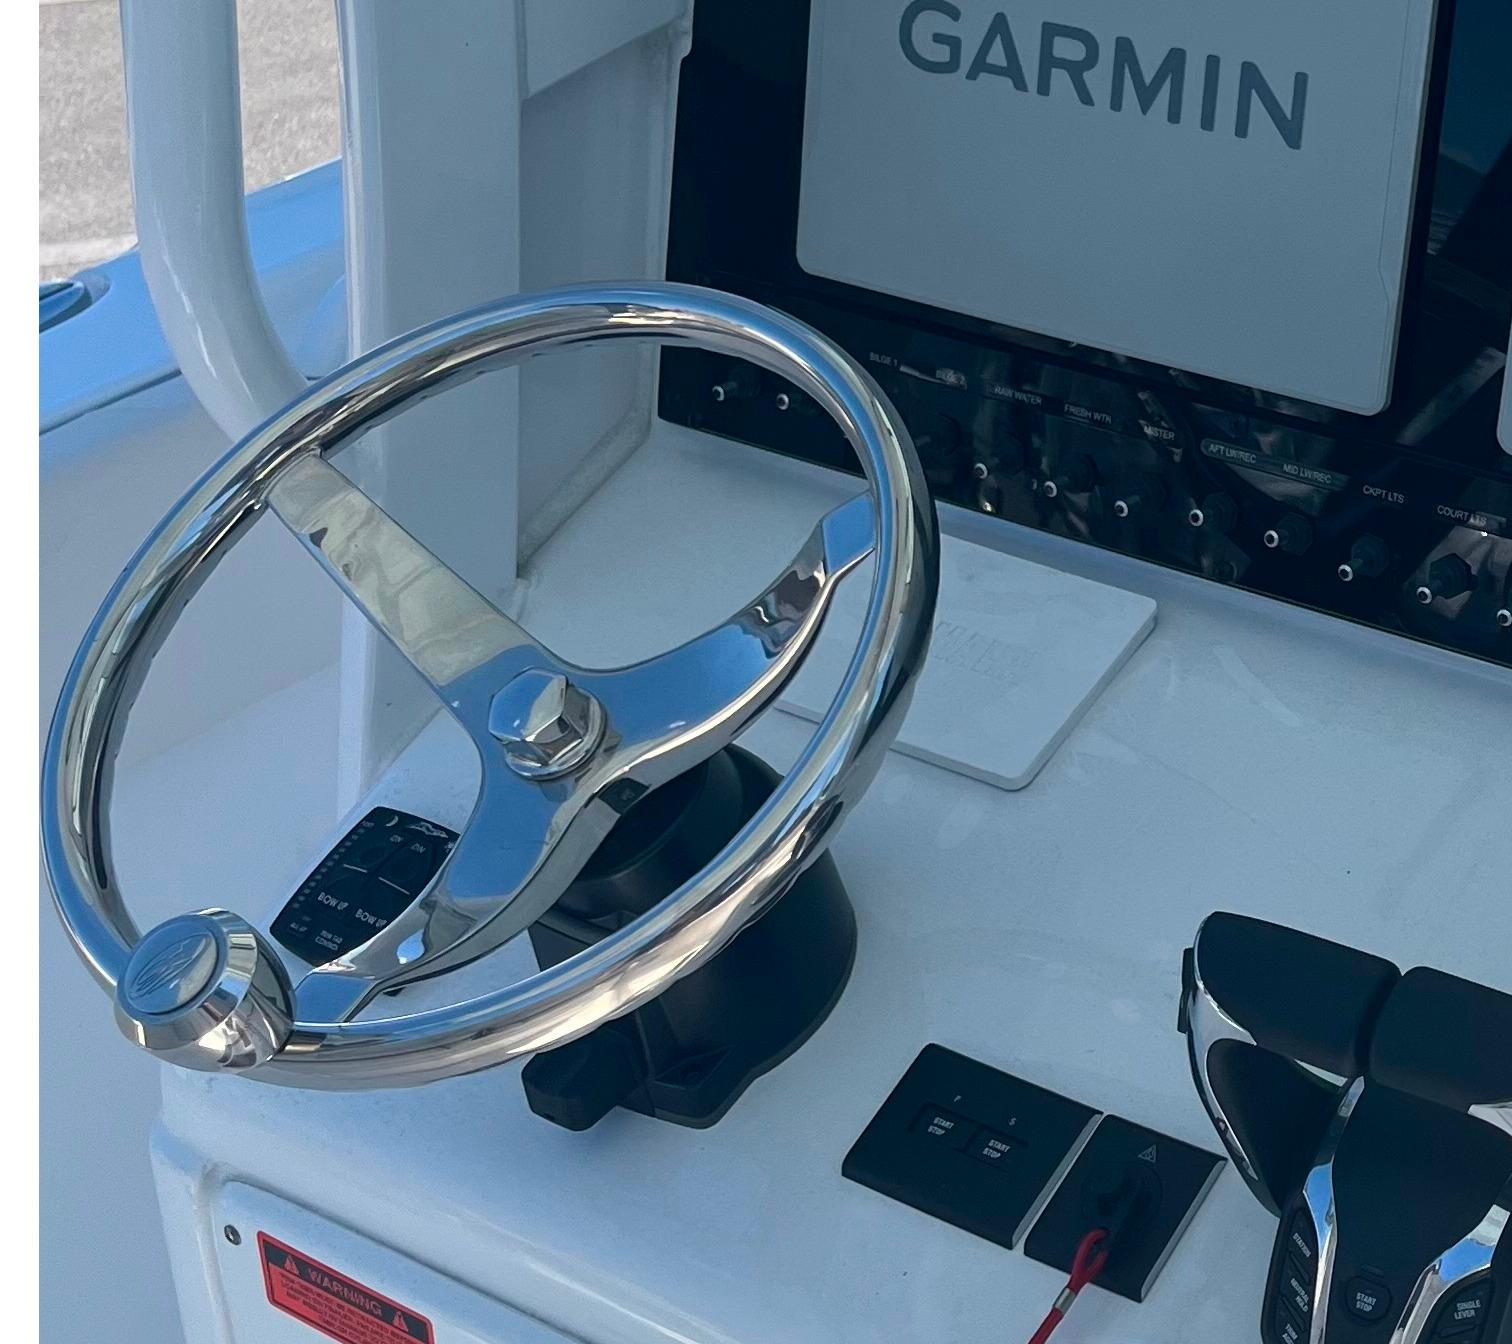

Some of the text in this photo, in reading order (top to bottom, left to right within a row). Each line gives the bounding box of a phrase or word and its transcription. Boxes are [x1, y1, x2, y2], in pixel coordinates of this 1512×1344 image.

[1208, 443, 1225, 455] AFT
[1282, 463, 1299, 475] MID
[1362, 485, 1404, 504] CKPT LTS
[1437, 505, 1487, 525] COURT LTS
[317, 891, 338, 907] BOW
[355, 908, 377, 925] BOW
[933, 1116, 954, 1129] START
[927, 1125, 946, 1136] STOP
[988, 1139, 1011, 1153] START
[982, 1147, 1001, 1159] STOP
[308, 1267, 383, 1318] WARNING
[1356, 1292, 1376, 1306] START
[1355, 1300, 1373, 1312] STOP
[1456, 1299, 1481, 1311] SINGLE
[1454, 1309, 1476, 1320] LEVER
